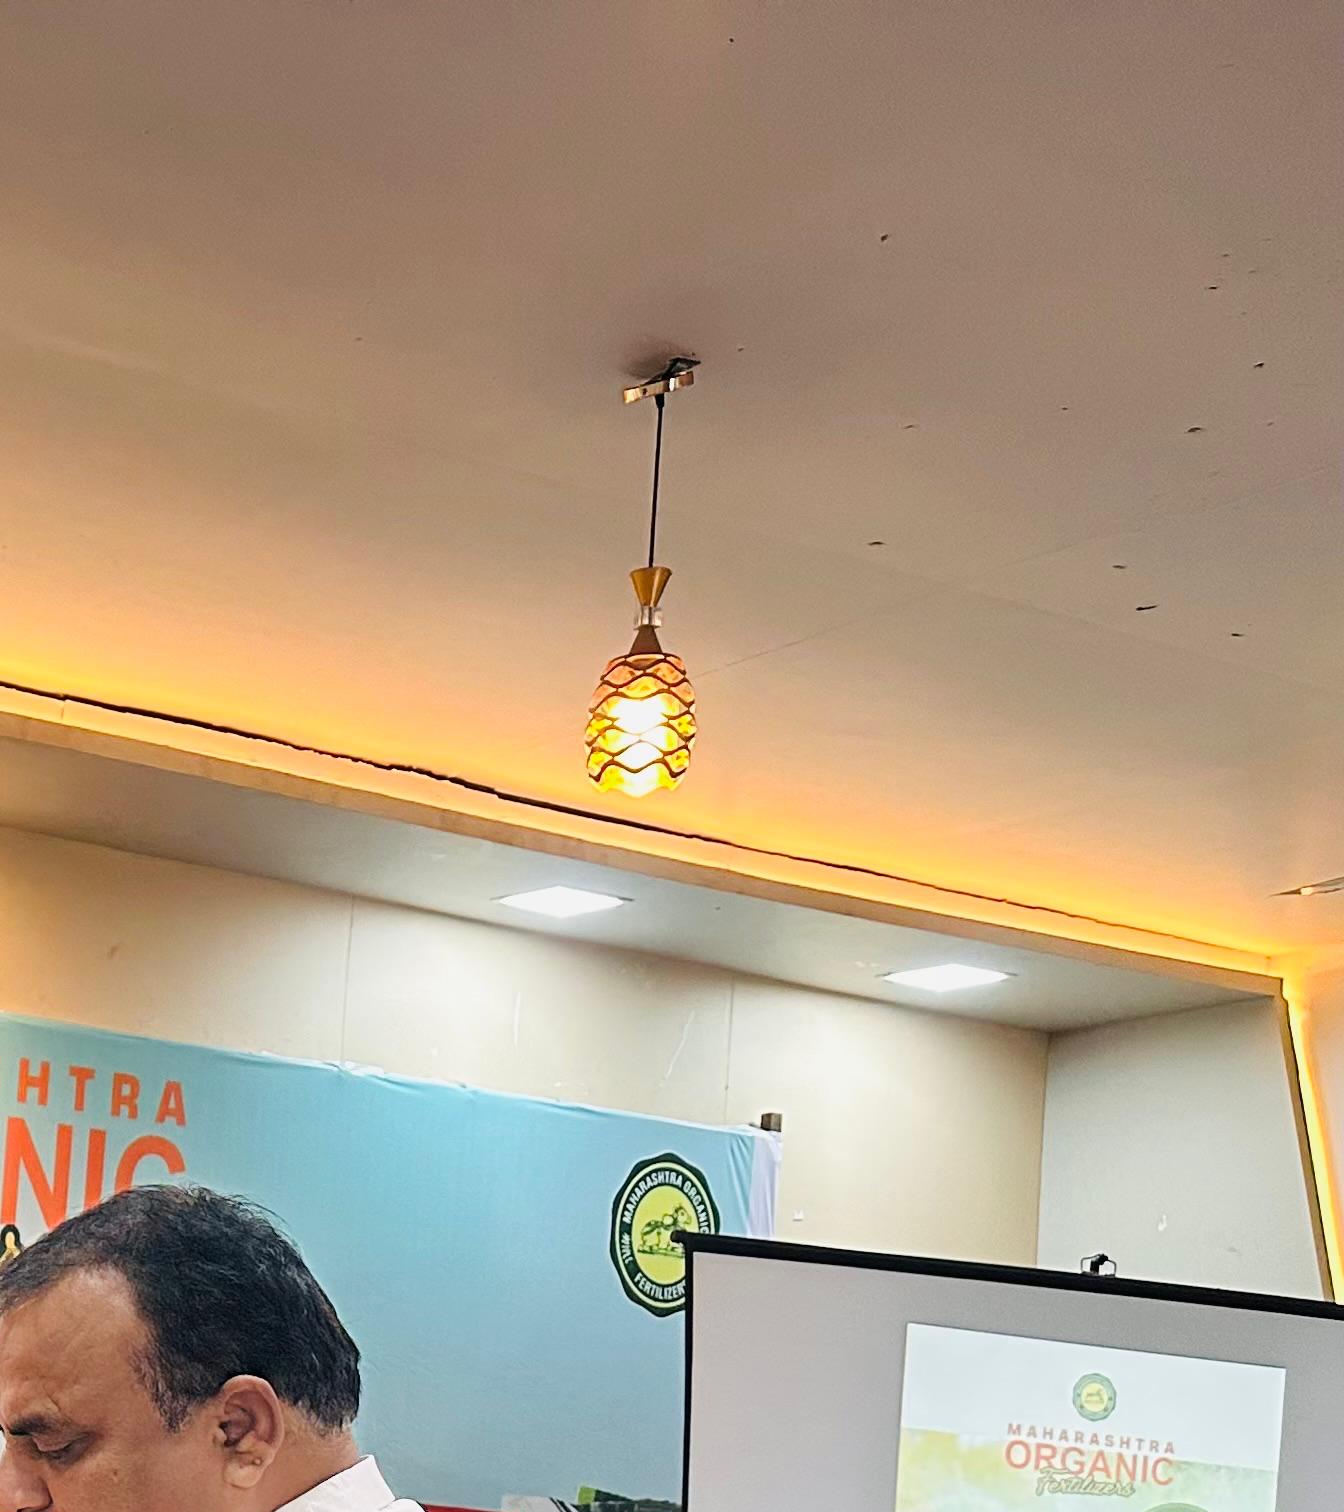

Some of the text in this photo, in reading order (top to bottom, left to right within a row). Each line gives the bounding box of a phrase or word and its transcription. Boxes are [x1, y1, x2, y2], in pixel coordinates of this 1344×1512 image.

[622, 1171, 683, 1225] MAHARASHTRA
[633, 1273, 686, 1300] FERTILIZER
[1007, 1423, 1176, 1454] MAHARASHTRA
[1004, 1439, 1176, 1486] ORGANIC
